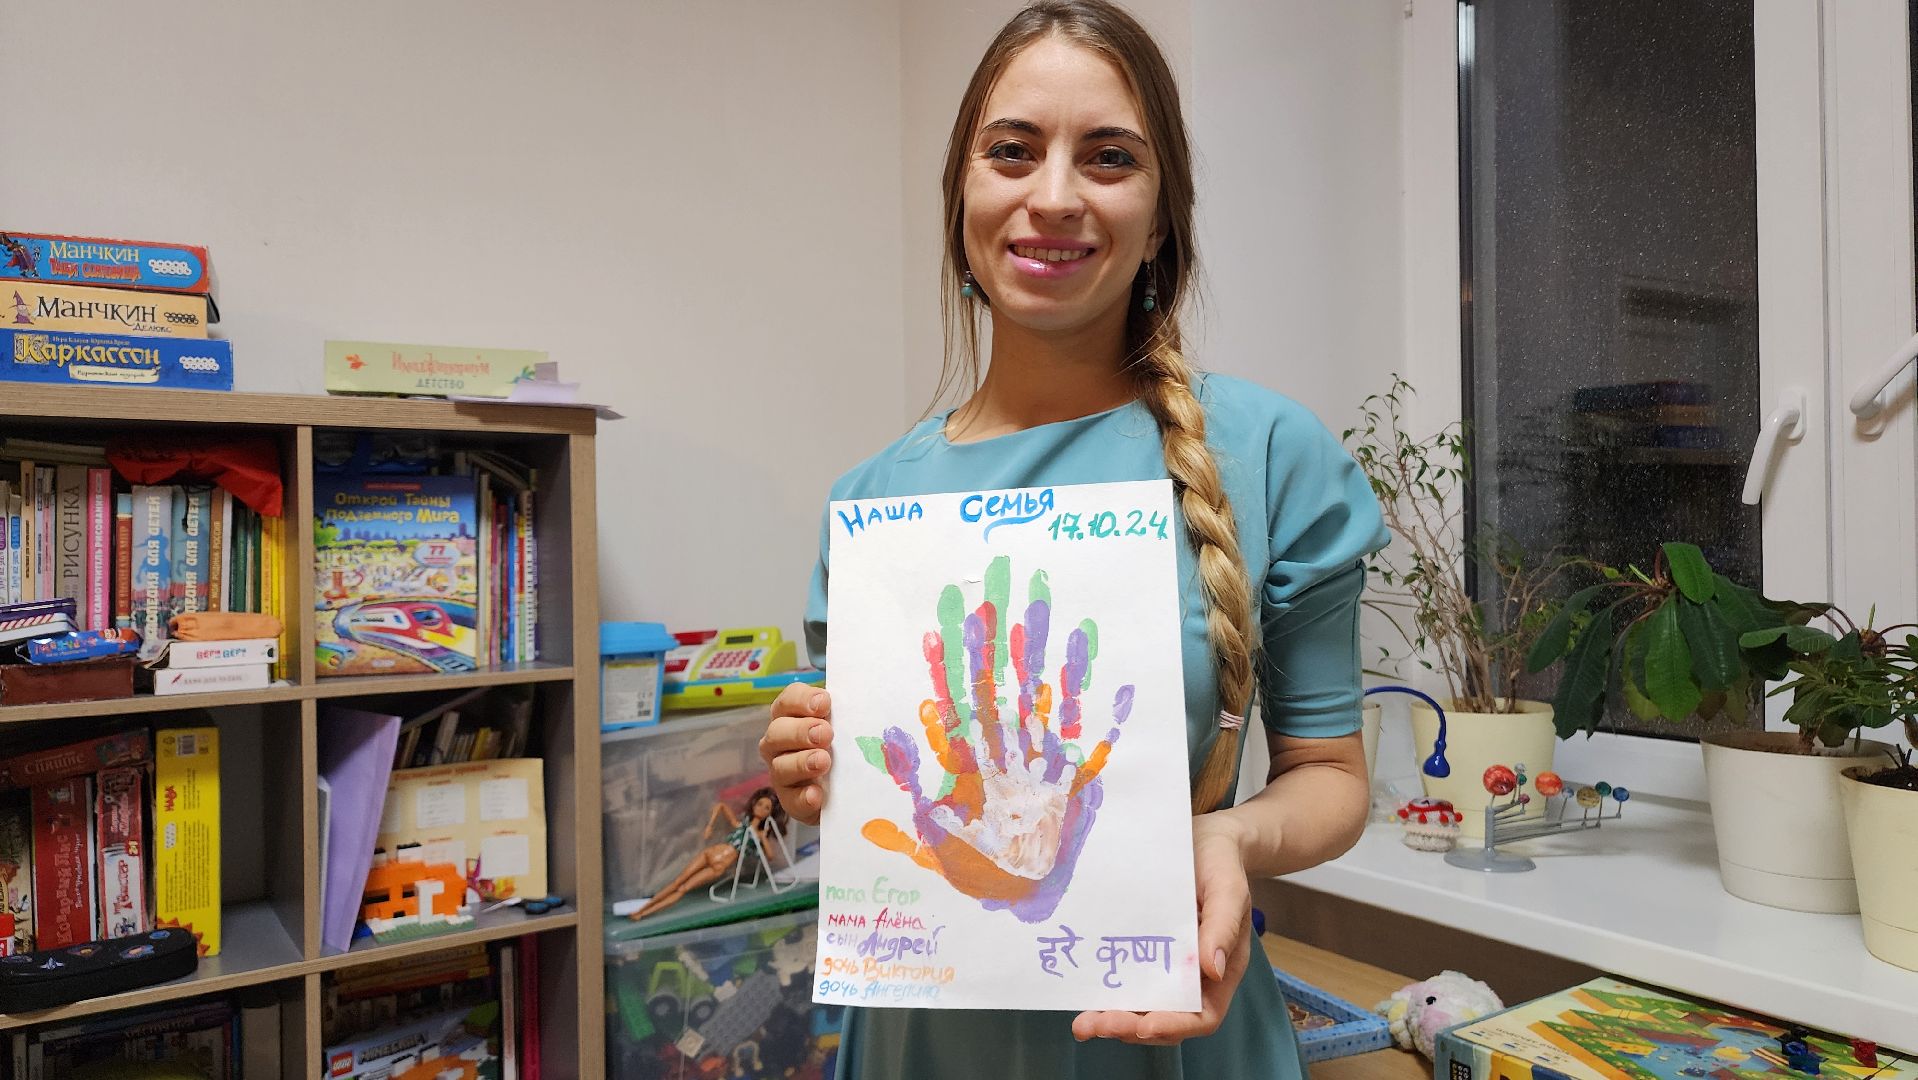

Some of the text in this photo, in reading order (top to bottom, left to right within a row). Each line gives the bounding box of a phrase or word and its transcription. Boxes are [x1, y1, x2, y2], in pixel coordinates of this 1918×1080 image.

[50, 241, 140, 265] Манчкин
[37, 296, 157, 326] Манчкин
[15, 334, 160, 367] Каркассон
[416, 378, 464, 389] ДЕТСТВО
[147, 495, 160, 536] ДЕТЕЙ
[416, 508, 461, 524] Мира
[1047, 510, 1168, 541] 17.10.24
[63, 485, 83, 578] РИСУНКА
[147, 539, 160, 566] ДЛЯ
[186, 540, 199, 566] ДЛЯ
[428, 545, 445, 556] 77
[863, 956, 956, 985] Виктория
[1036, 925, 1176, 988] हरे कृष्ण
